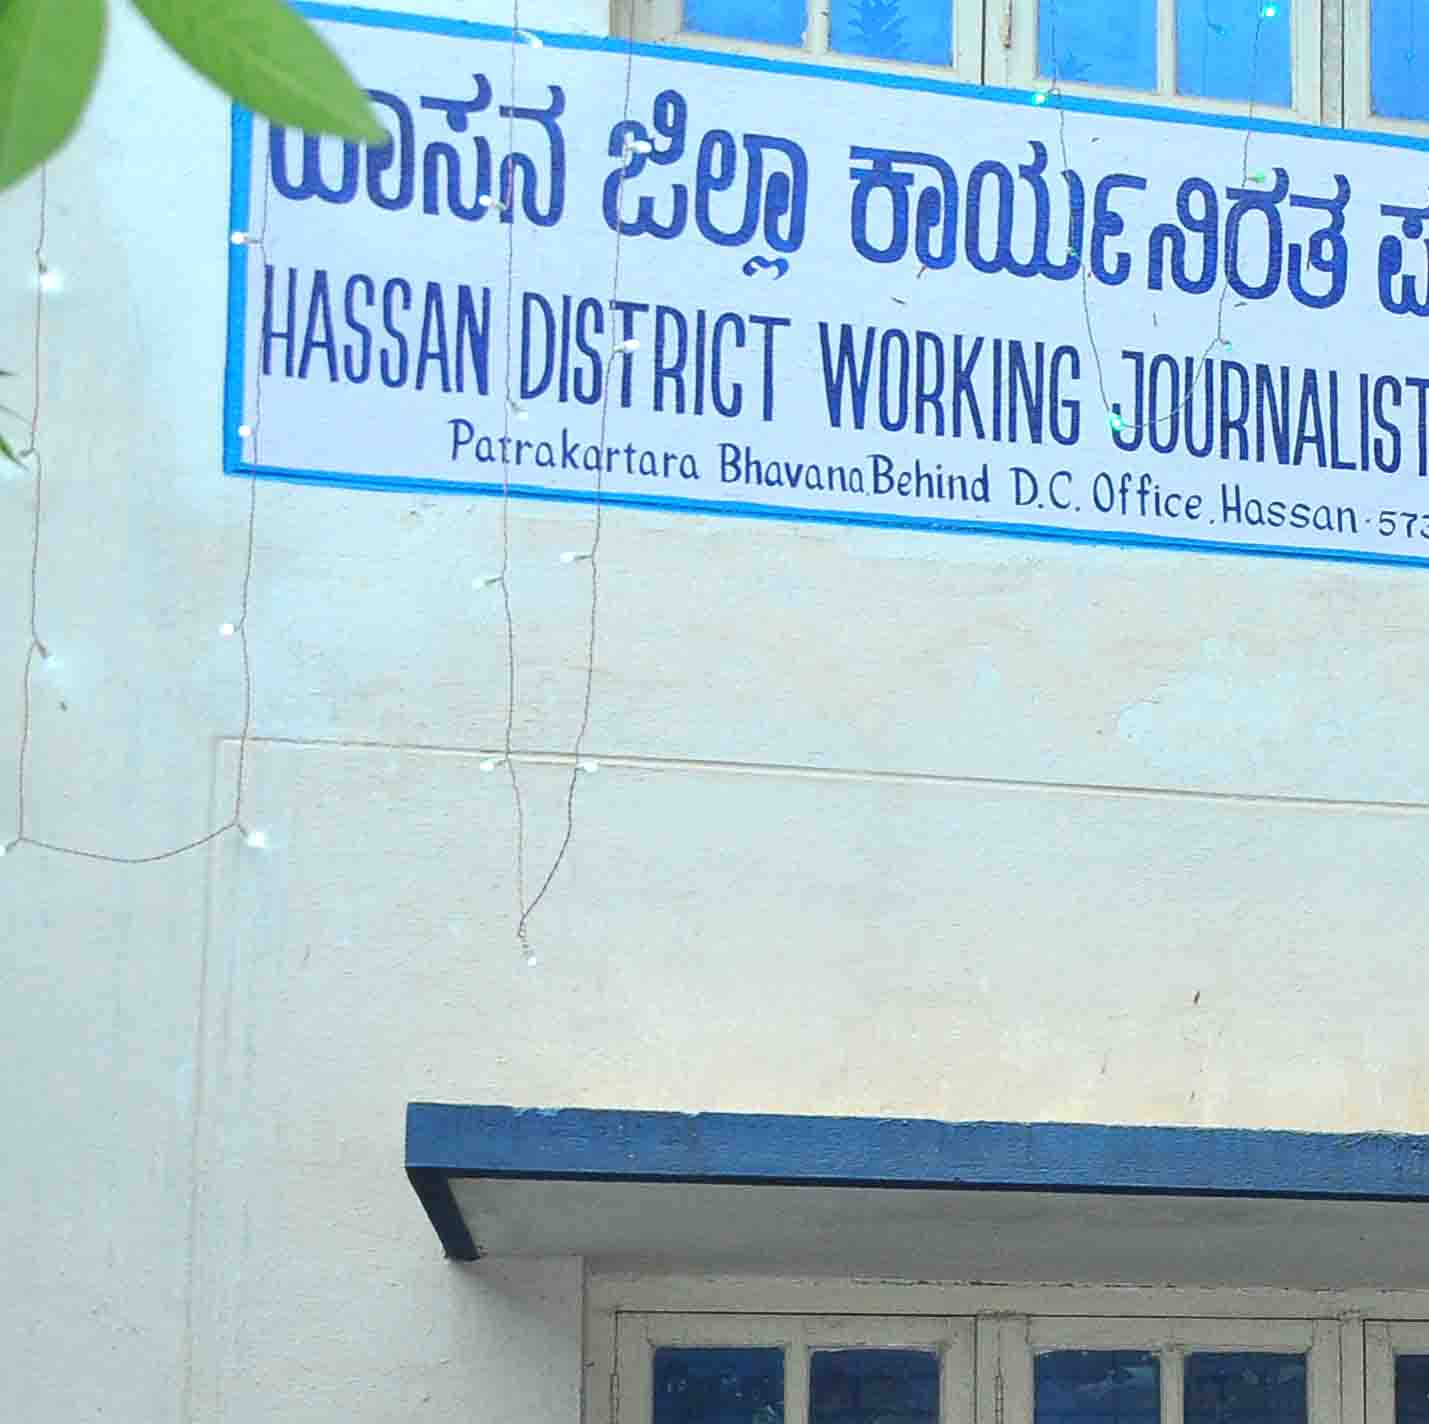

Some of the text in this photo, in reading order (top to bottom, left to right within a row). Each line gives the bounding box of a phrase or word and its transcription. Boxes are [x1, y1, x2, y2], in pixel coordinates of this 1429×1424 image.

[603, 90, 807, 277] ಜಿಲ್ಲಾ
[262, 265, 490, 395] HASSAN
[521, 292, 790, 421] DISTRICT
[819, 322, 1080, 445] WORKING
[448, 418, 699, 480] Patrakartara
[1011, 467, 1081, 514] D.C.
